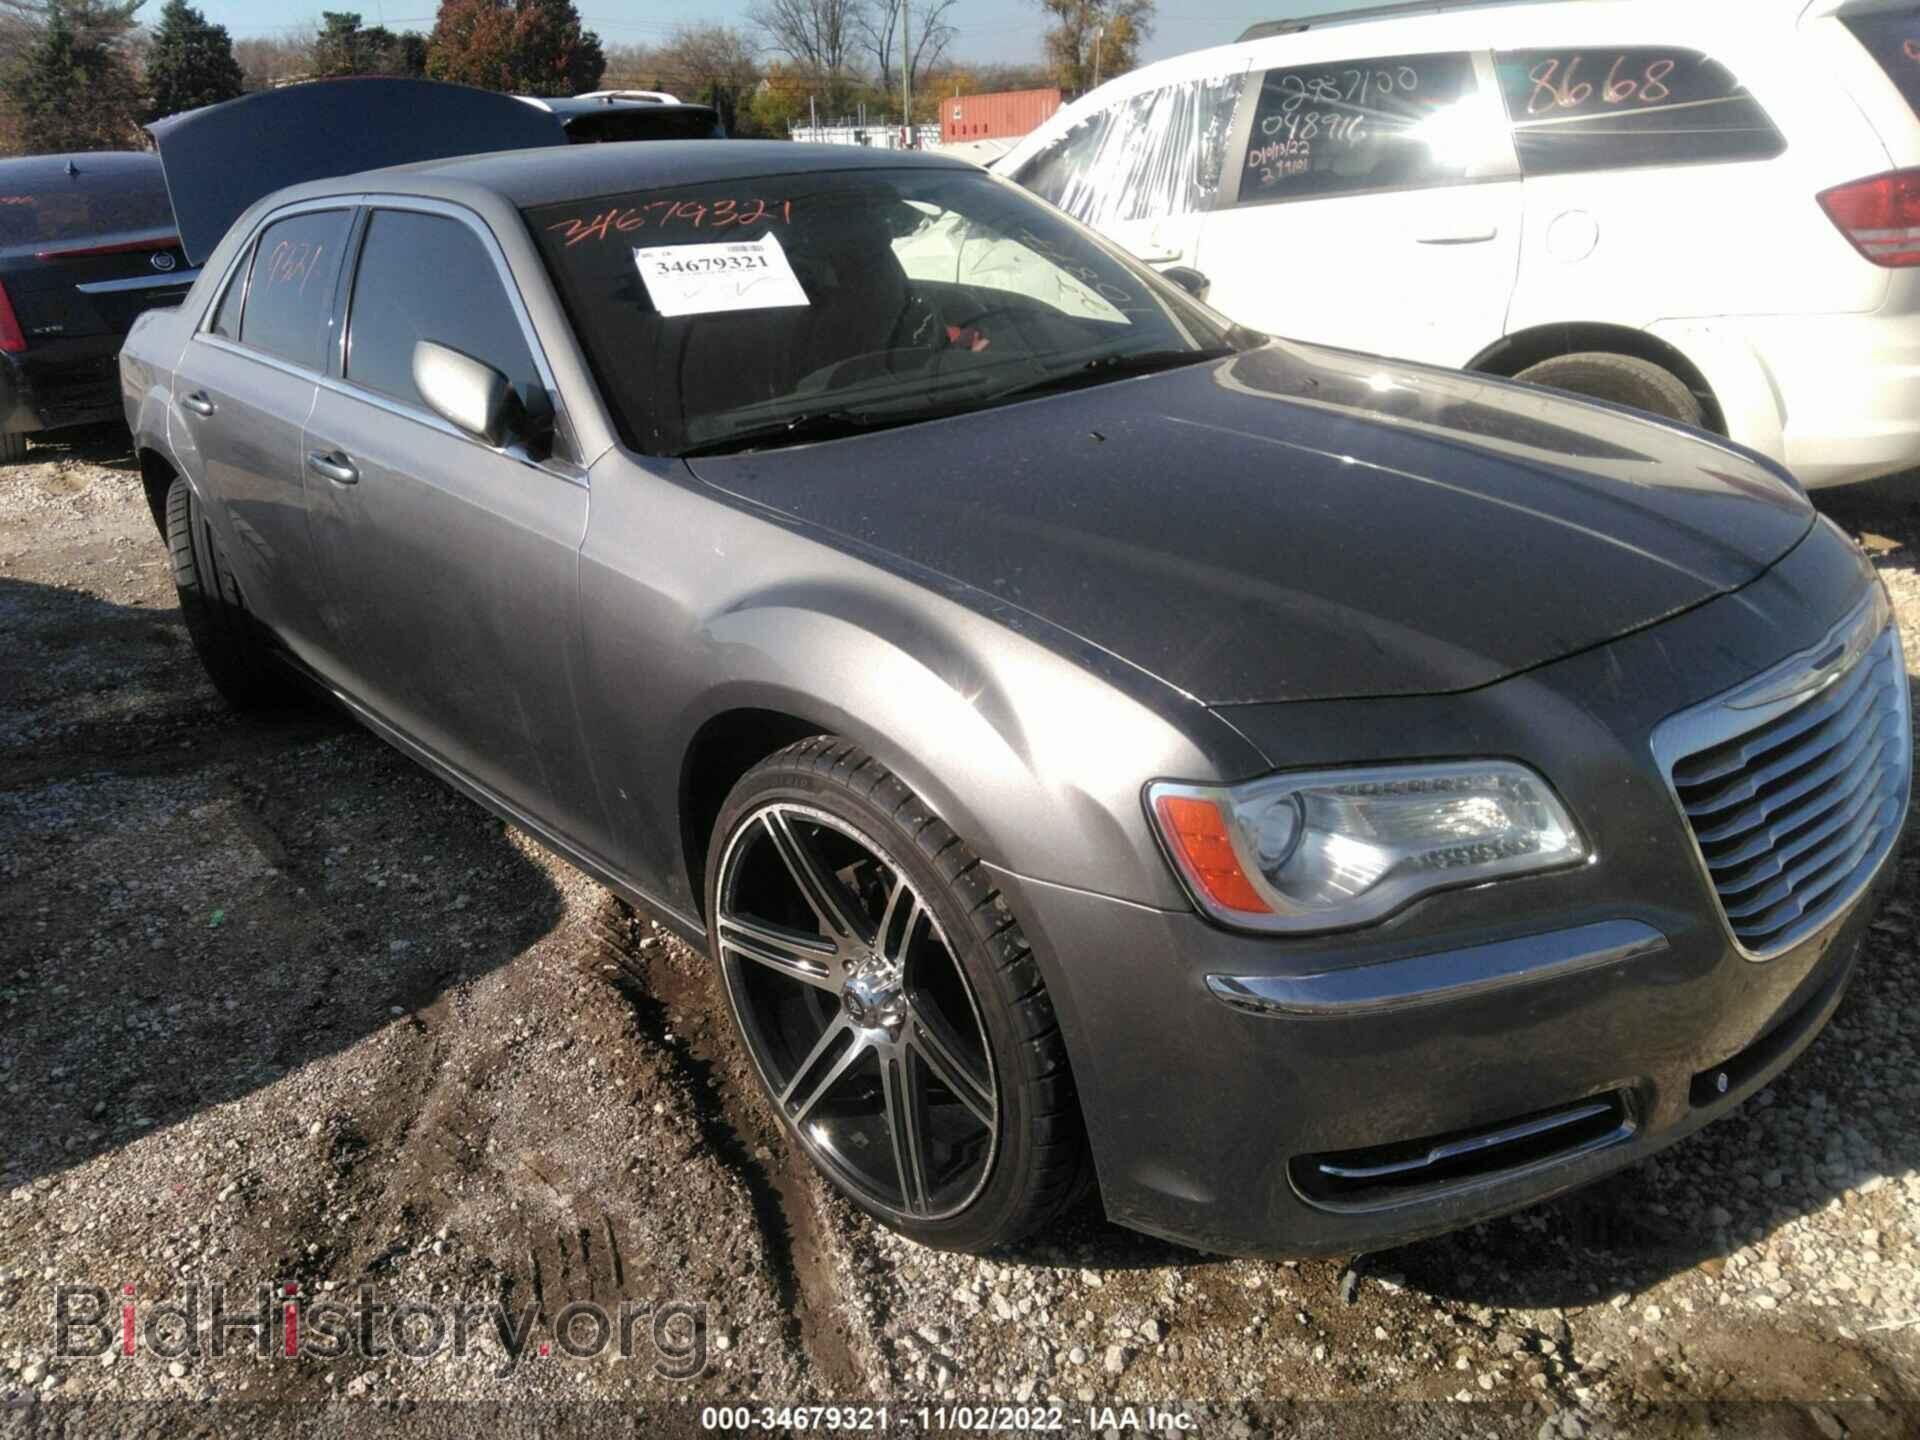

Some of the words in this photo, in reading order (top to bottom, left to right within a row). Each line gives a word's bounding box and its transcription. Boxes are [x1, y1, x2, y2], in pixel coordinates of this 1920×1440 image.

[1527, 55, 1677, 114] 8668
[548, 199, 792, 247] 34679321
[655, 255, 769, 275] 34679321
